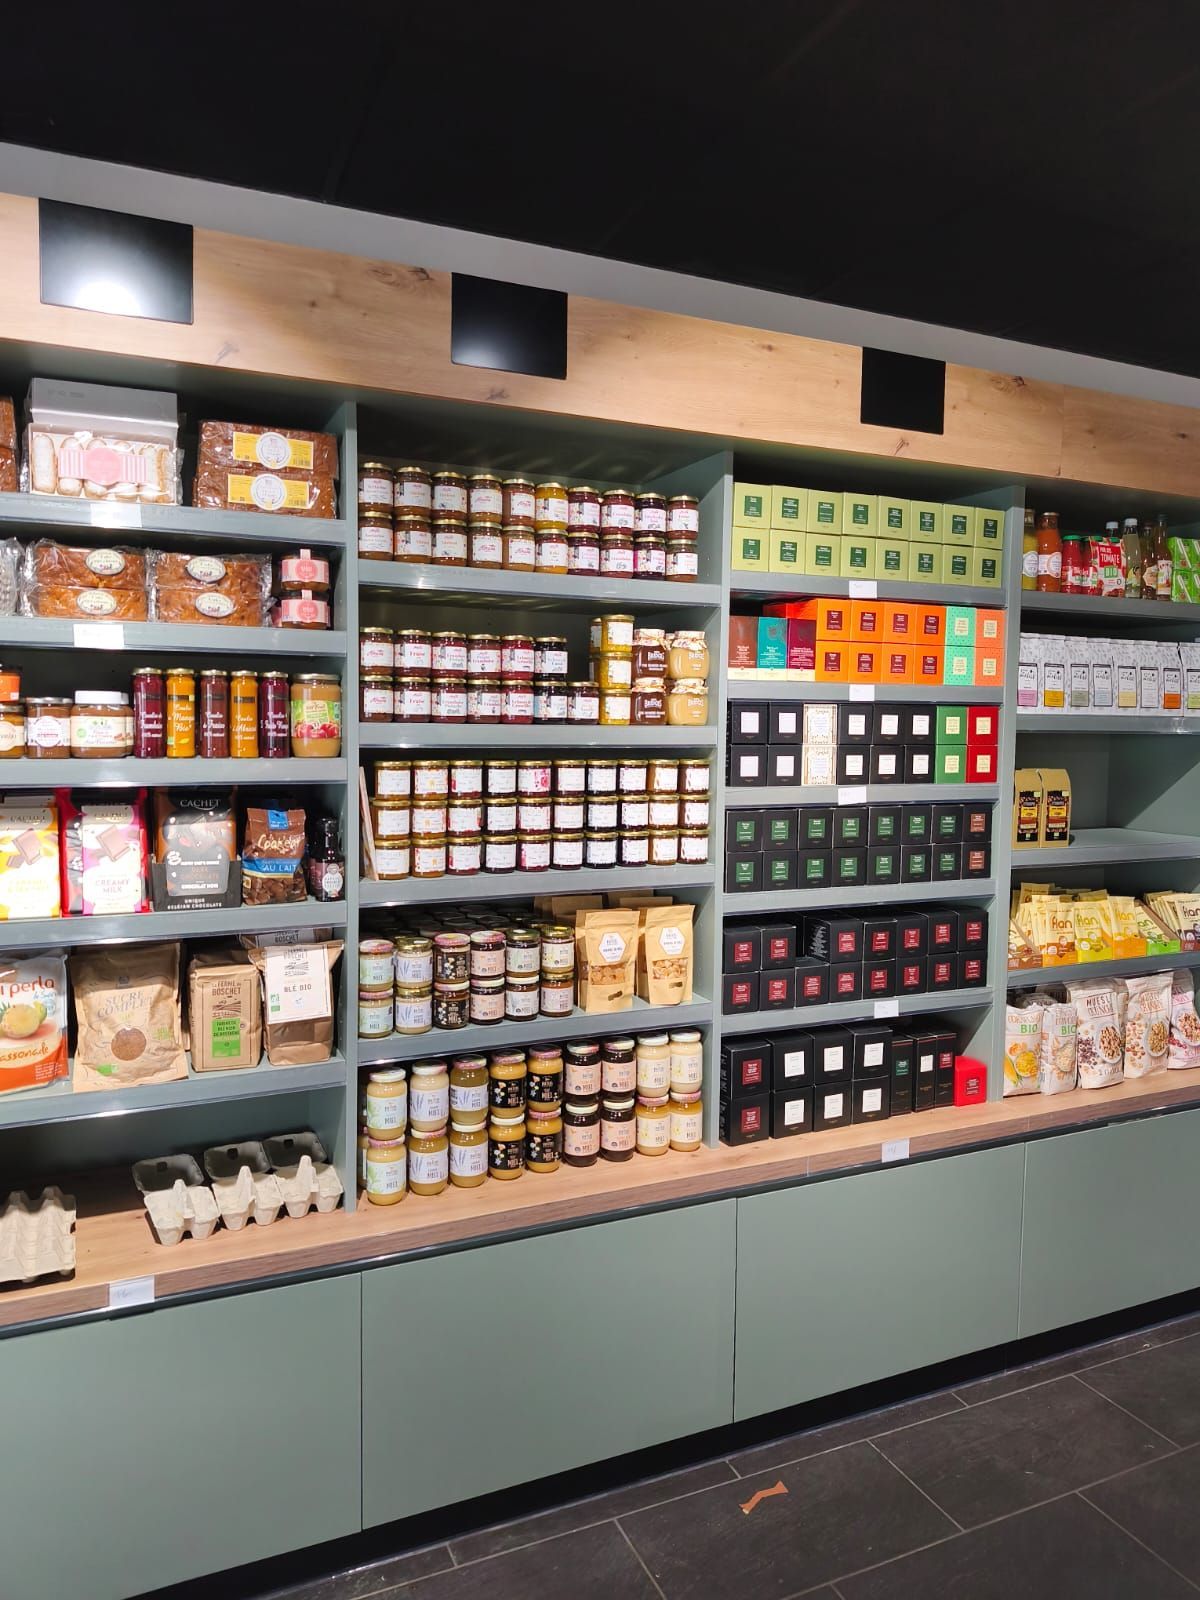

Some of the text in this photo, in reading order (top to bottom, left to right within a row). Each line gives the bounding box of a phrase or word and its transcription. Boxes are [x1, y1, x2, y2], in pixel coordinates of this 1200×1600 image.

[1100, 553, 1121, 565] TOMATE
[180, 799, 221, 809] CACHET
[1051, 914, 1073, 929] flan
[1077, 912, 1098, 926] flan
[9, 975, 54, 998] perla
[212, 987, 241, 996] BOSCHET
[299, 983, 312, 991] BIO
[1020, 1023, 1038, 1033] BIO
[1060, 1025, 1076, 1036] BIO
